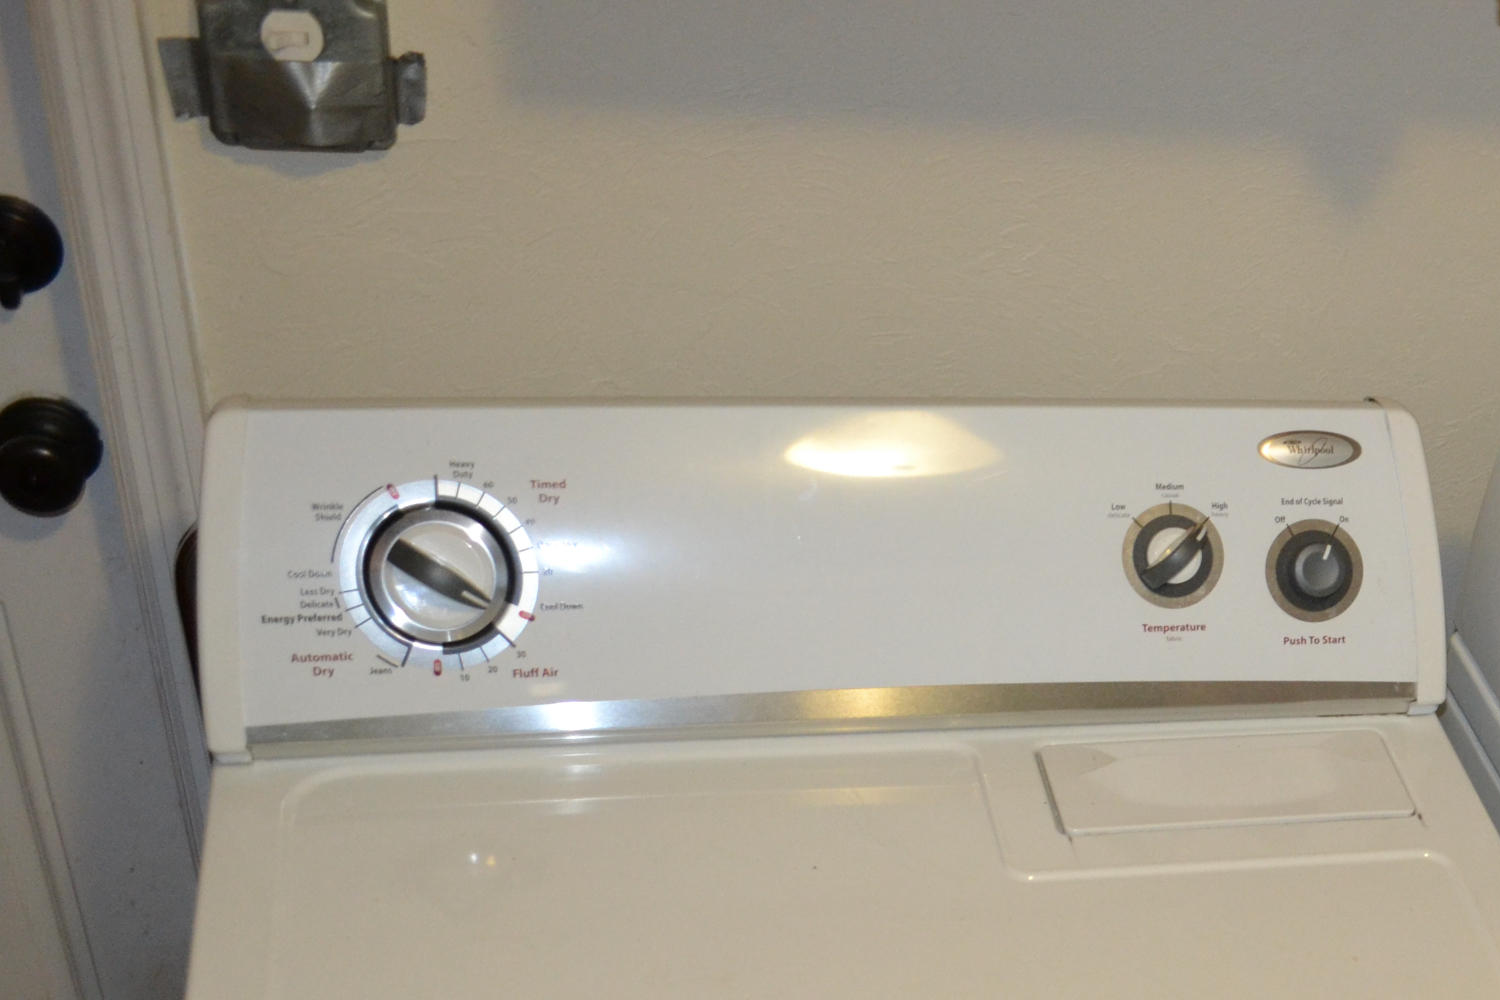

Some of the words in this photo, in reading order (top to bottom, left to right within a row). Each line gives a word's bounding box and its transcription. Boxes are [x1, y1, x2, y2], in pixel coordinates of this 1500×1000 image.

[1288, 443, 1335, 456] Whirlpool
[449, 460, 475, 470] Heavy
[453, 470, 473, 480] Duty
[483, 481, 494, 489] 60
[530, 479, 567, 490] Timed
[1155, 483, 1184, 491] Medium
[507, 496, 518, 505] 50
[539, 493, 560, 505] Dry
[1281, 497, 1294, 506] End
[1296, 497, 1303, 506] of
[1304, 497, 1321, 507] Cycle
[1323, 497, 1343, 507] Signal
[312, 503, 343, 511] Wrinkle
[1211, 501, 1228, 511] High
[315, 513, 341, 521] Shield
[1274, 515, 1286, 524] Off
[1339, 515, 1349, 523] On
[300, 588, 317, 596] Less
[320, 588, 335, 597] Dry
[300, 601, 334, 609] Delicate
[261, 614, 295, 625] Energy
[297, 612, 343, 624] Preferred
[316, 629, 335, 638] Very
[337, 628, 352, 637] Dry
[1142, 623, 1206, 634] Temperature
[1283, 636, 1307, 645] Push
[1309, 635, 1320, 645] To
[1322, 635, 1346, 644] Start
[291, 652, 353, 664] Automatic
[516, 650, 527, 658] 30
[313, 666, 334, 678] Dry
[370, 666, 392, 675] Jeans
[488, 665, 498, 674] 20
[513, 668, 539, 679] Fluff
[542, 667, 559, 678] Air
[460, 674, 470, 682] 10
